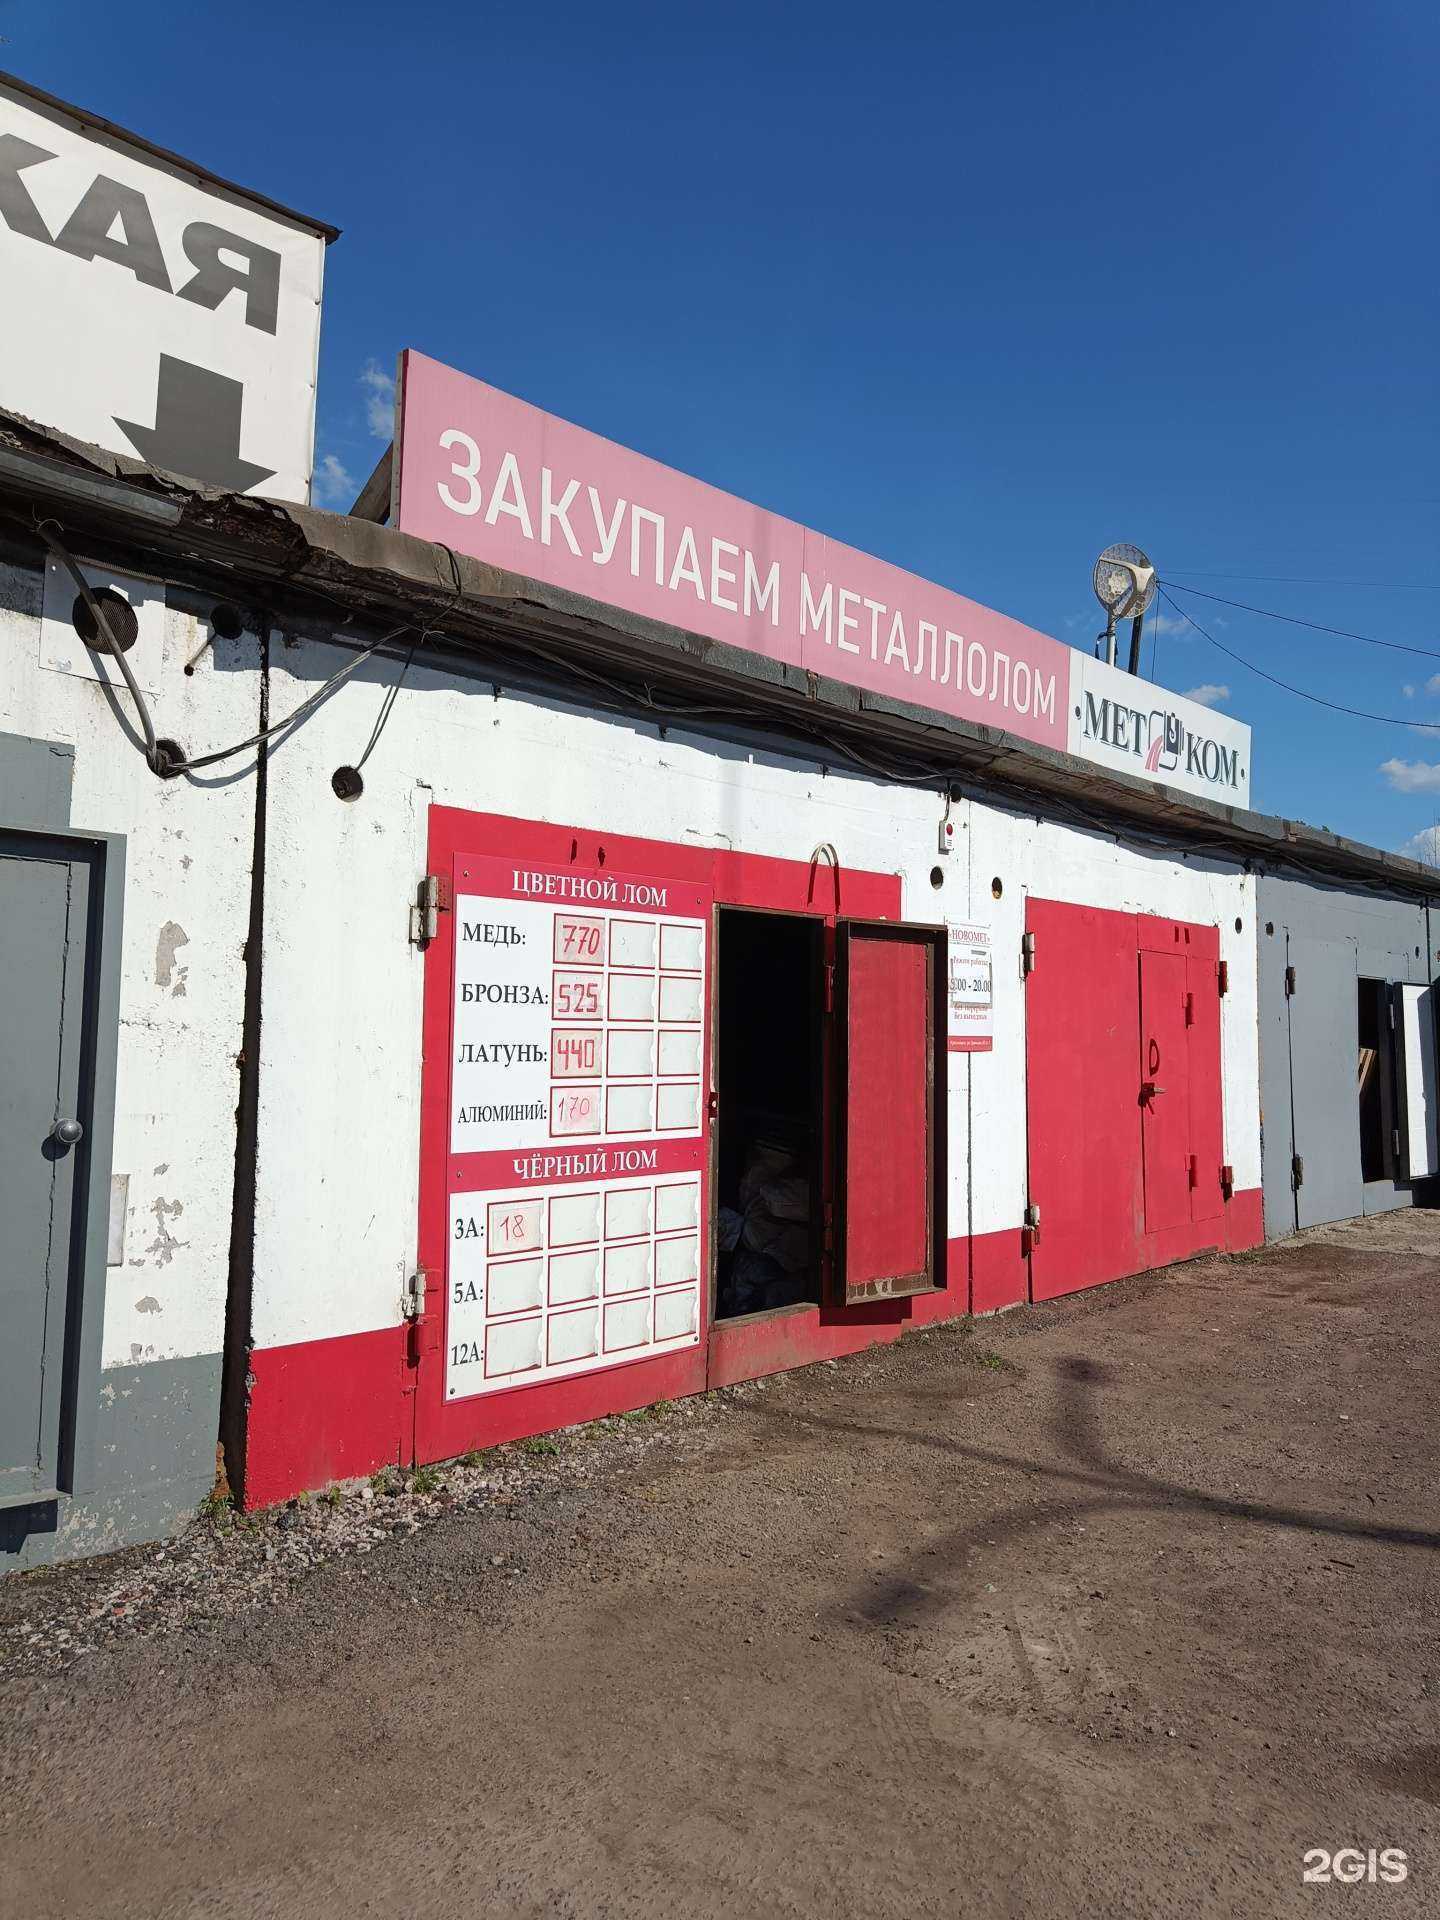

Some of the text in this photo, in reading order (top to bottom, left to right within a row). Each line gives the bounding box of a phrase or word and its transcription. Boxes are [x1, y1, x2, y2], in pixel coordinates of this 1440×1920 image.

[437, 429, 1056, 724] ЗАКУПАЕМ МЕТАЛЛОЛОМ
[511, 870, 668, 907] ЦВЕТНОЙ ЛОМ
[462, 922, 600, 955] МЕДЬ: 770
[461, 983, 598, 1013] БРОНЗА: 525
[458, 1039, 595, 1070] ЛАТУНЬ: 440
[458, 1096, 590, 1123] АЛЮМИНИЙ: 170
[513, 1148, 659, 1179] ЧЁРНЫЙ ЛОМ
[499, 1214, 526, 1241] 18
[454, 1281, 485, 1303] 5А:
[451, 1341, 485, 1366] 12А:
